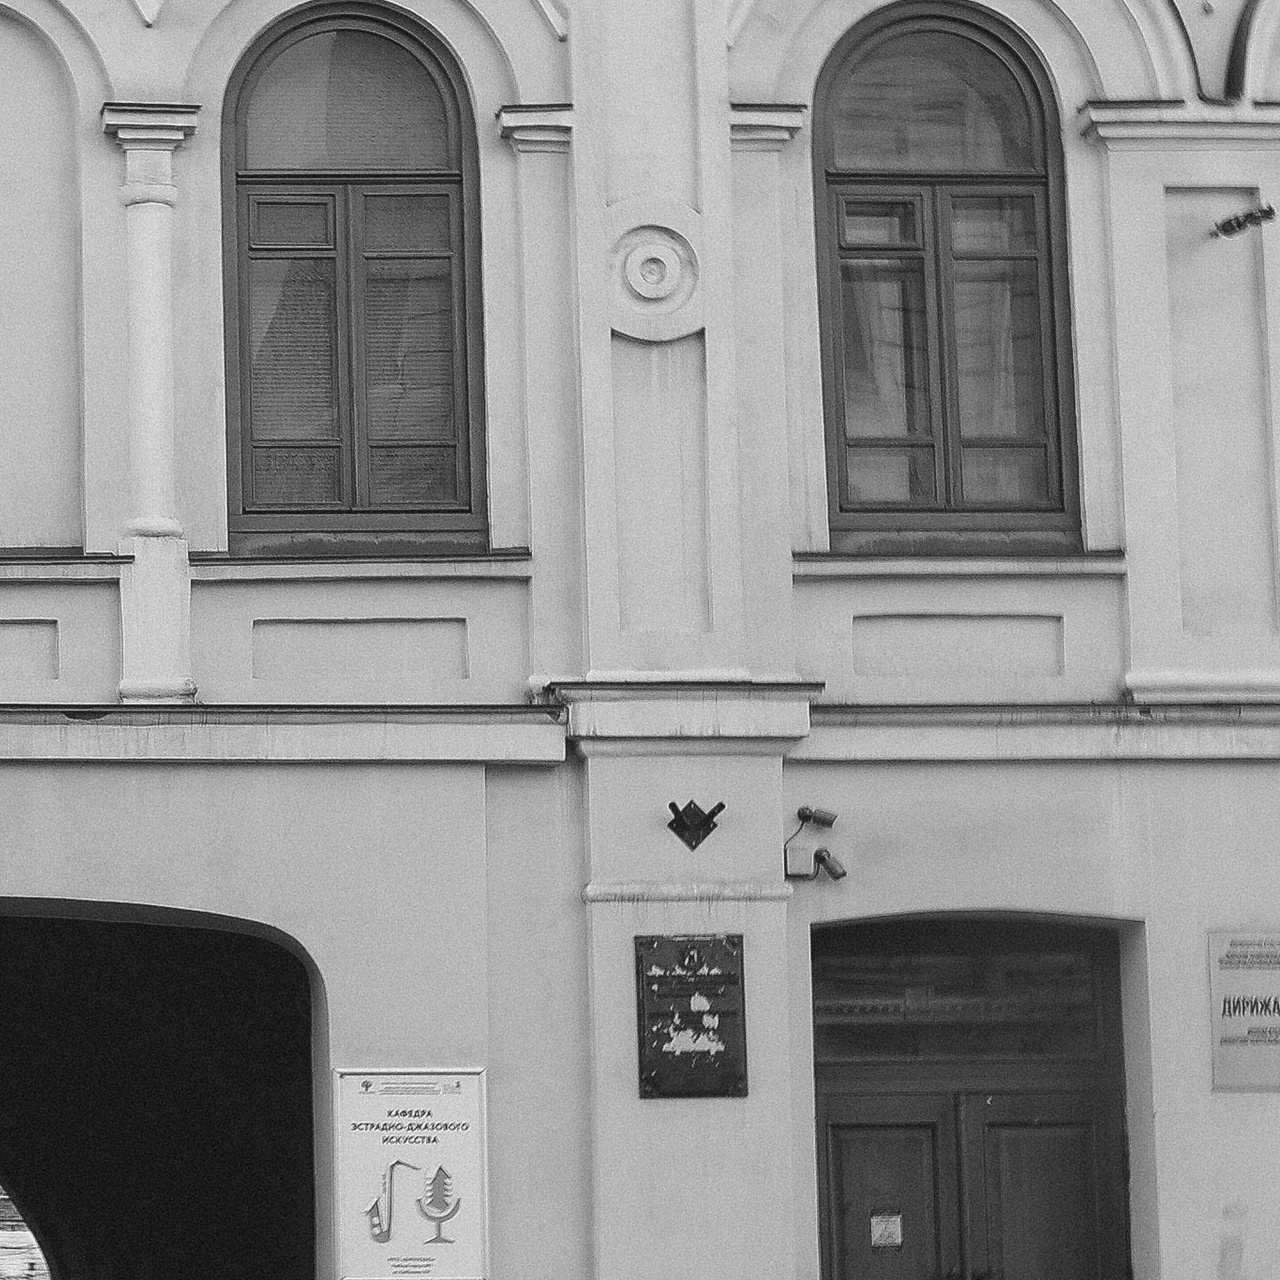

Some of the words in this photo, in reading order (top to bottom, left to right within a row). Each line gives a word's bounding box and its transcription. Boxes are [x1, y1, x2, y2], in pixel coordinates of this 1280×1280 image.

[386, 1109, 433, 1119] КАФЕДРА
[350, 1122, 470, 1132] ЭСТРАДНО-ДЖАЗОВОГО
[381, 1135, 439, 1145] ИСКУССТВА
